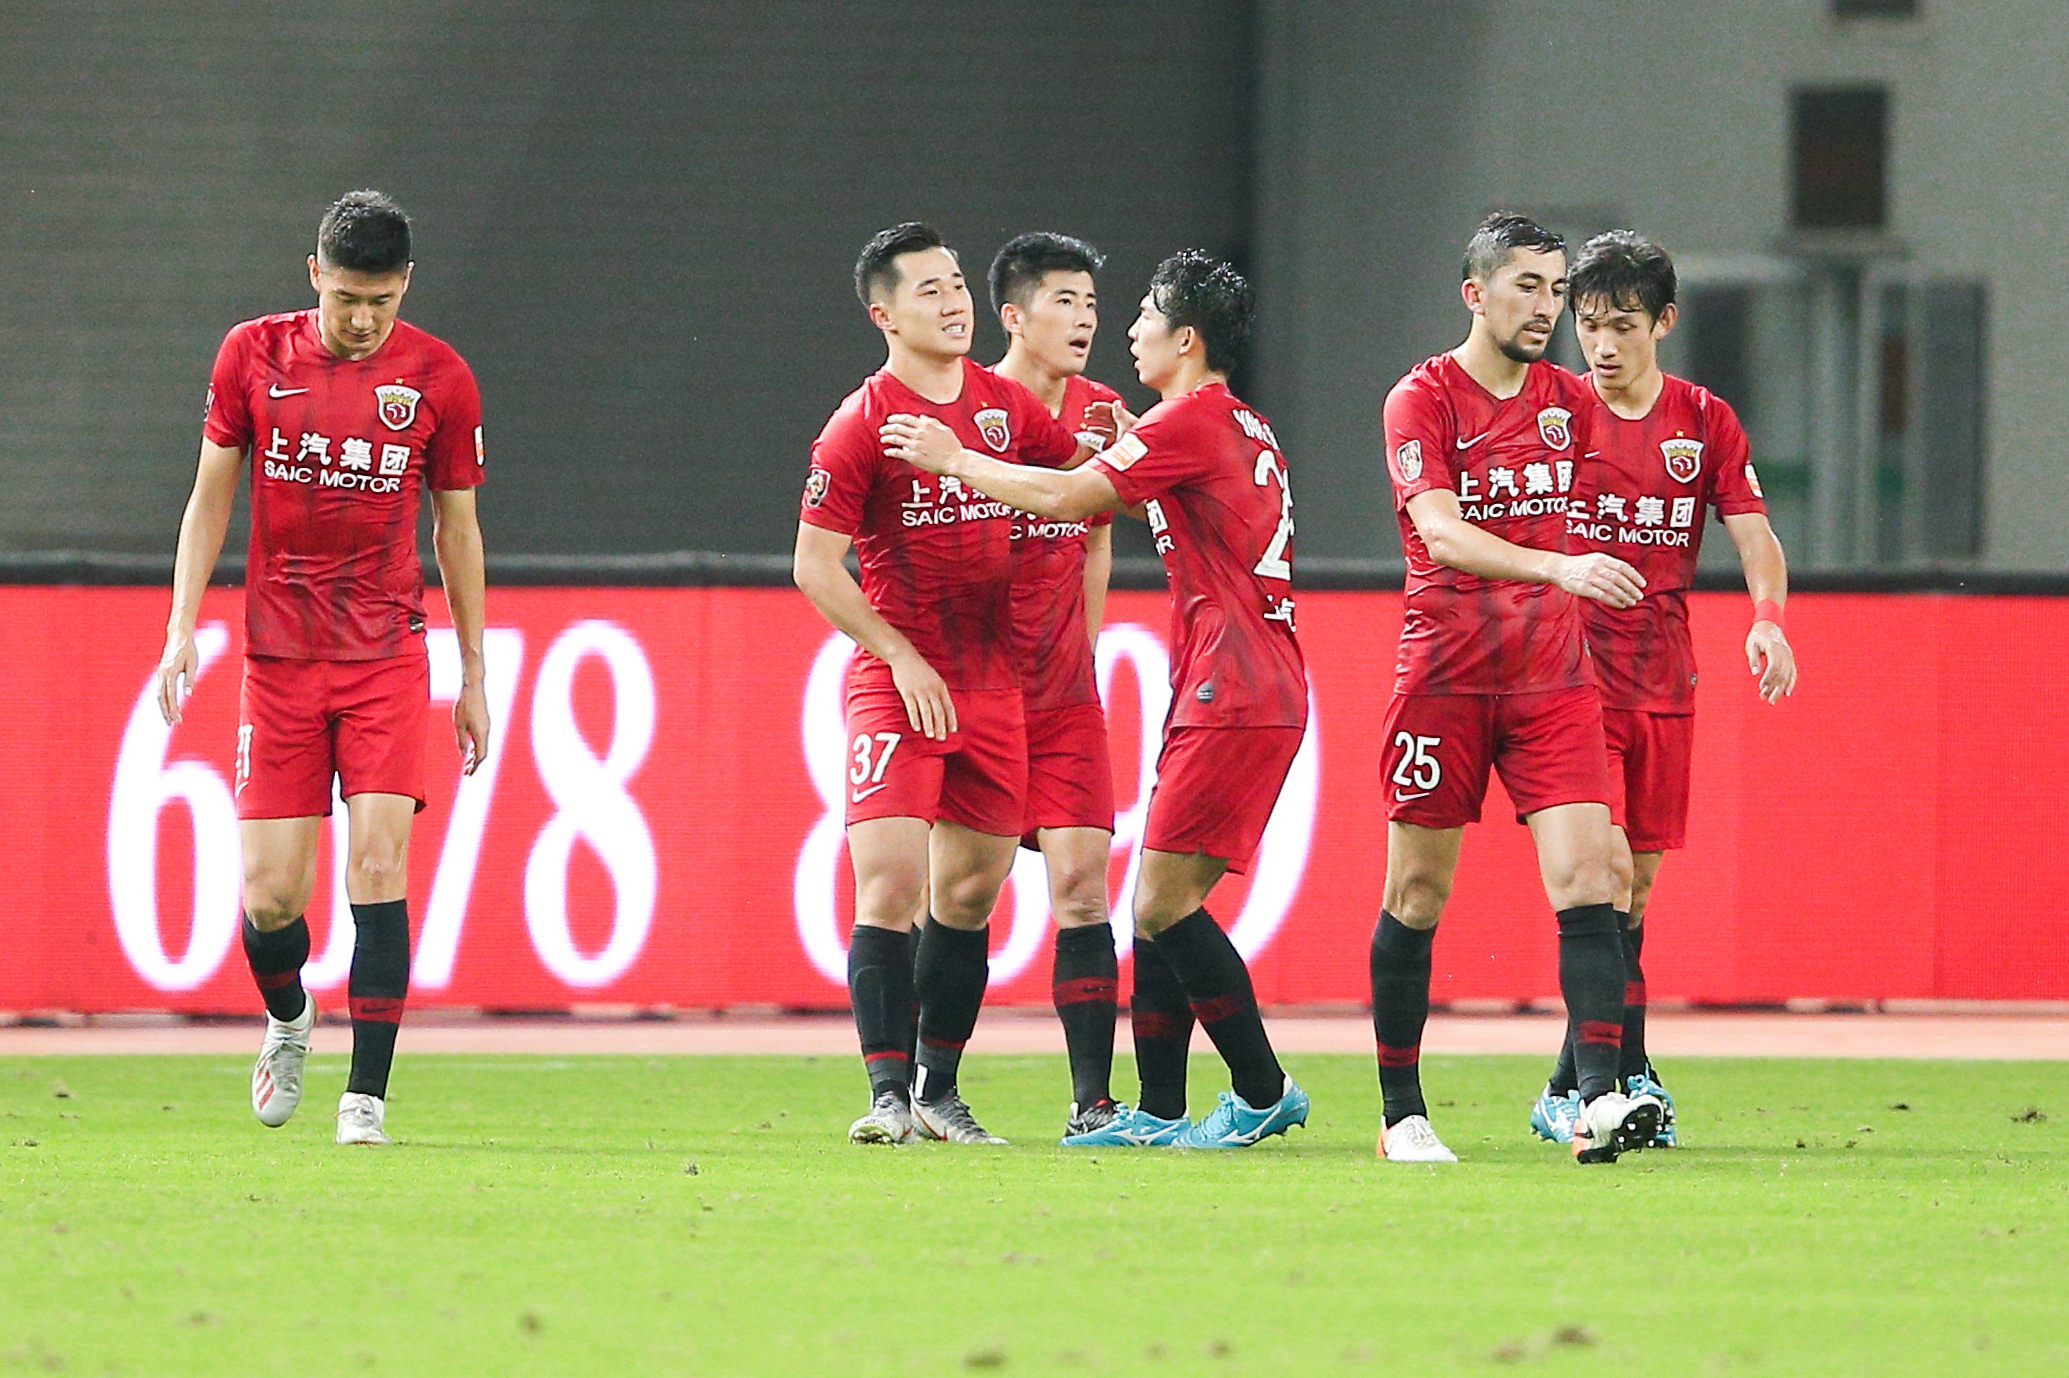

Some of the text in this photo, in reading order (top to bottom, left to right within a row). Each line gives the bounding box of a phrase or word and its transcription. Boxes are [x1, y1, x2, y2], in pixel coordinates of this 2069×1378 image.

[264, 427, 411, 475] 上汽集团
[264, 459, 401, 493] SAIC MOTOR
[902, 508, 955, 527] SAIC
[1459, 503, 1505, 521] AIC
[1618, 528, 1690, 548] MOTOR
[849, 732, 902, 785] 37
[1392, 731, 1441, 790] 25
